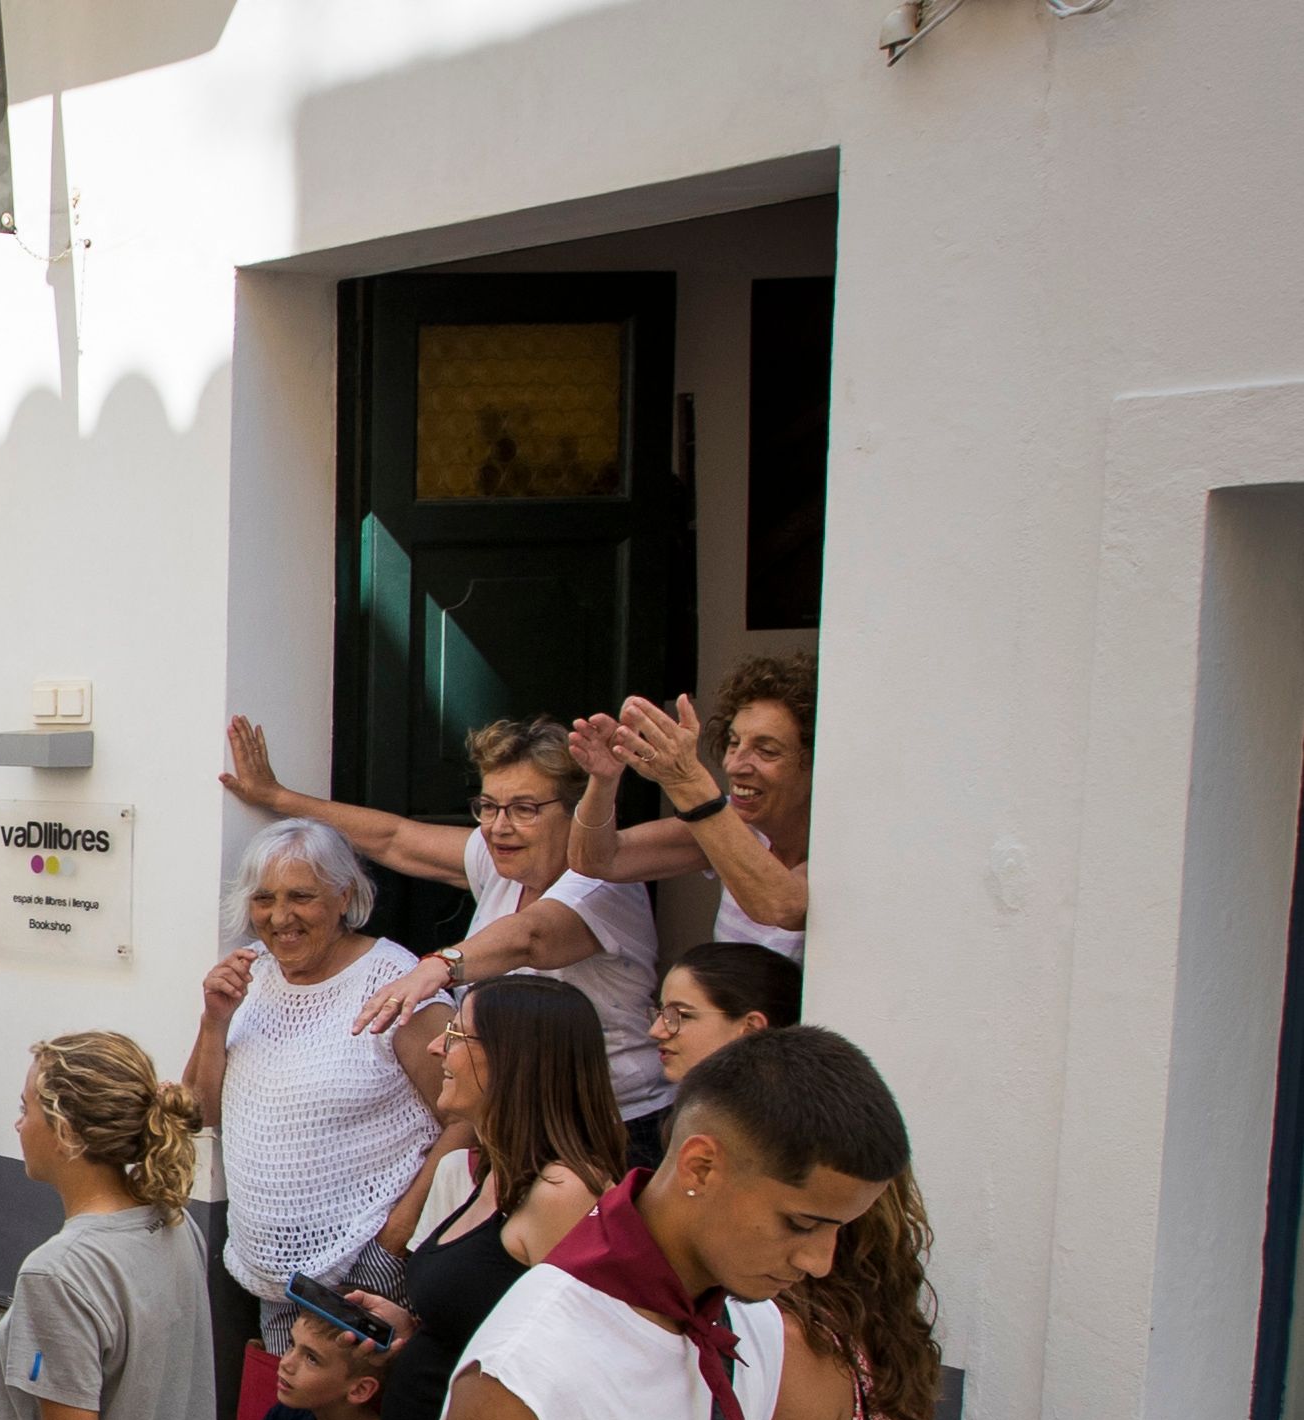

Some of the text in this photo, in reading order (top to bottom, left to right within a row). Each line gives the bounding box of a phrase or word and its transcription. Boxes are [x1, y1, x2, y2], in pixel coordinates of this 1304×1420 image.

[0, 821, 110, 853] vaDllibres
[13, 894, 33, 905] espai
[33, 896, 44, 905] de
[45, 896, 67, 907] llibres
[72, 898, 100, 911] llengua
[29, 918, 72, 934] Bookshop
